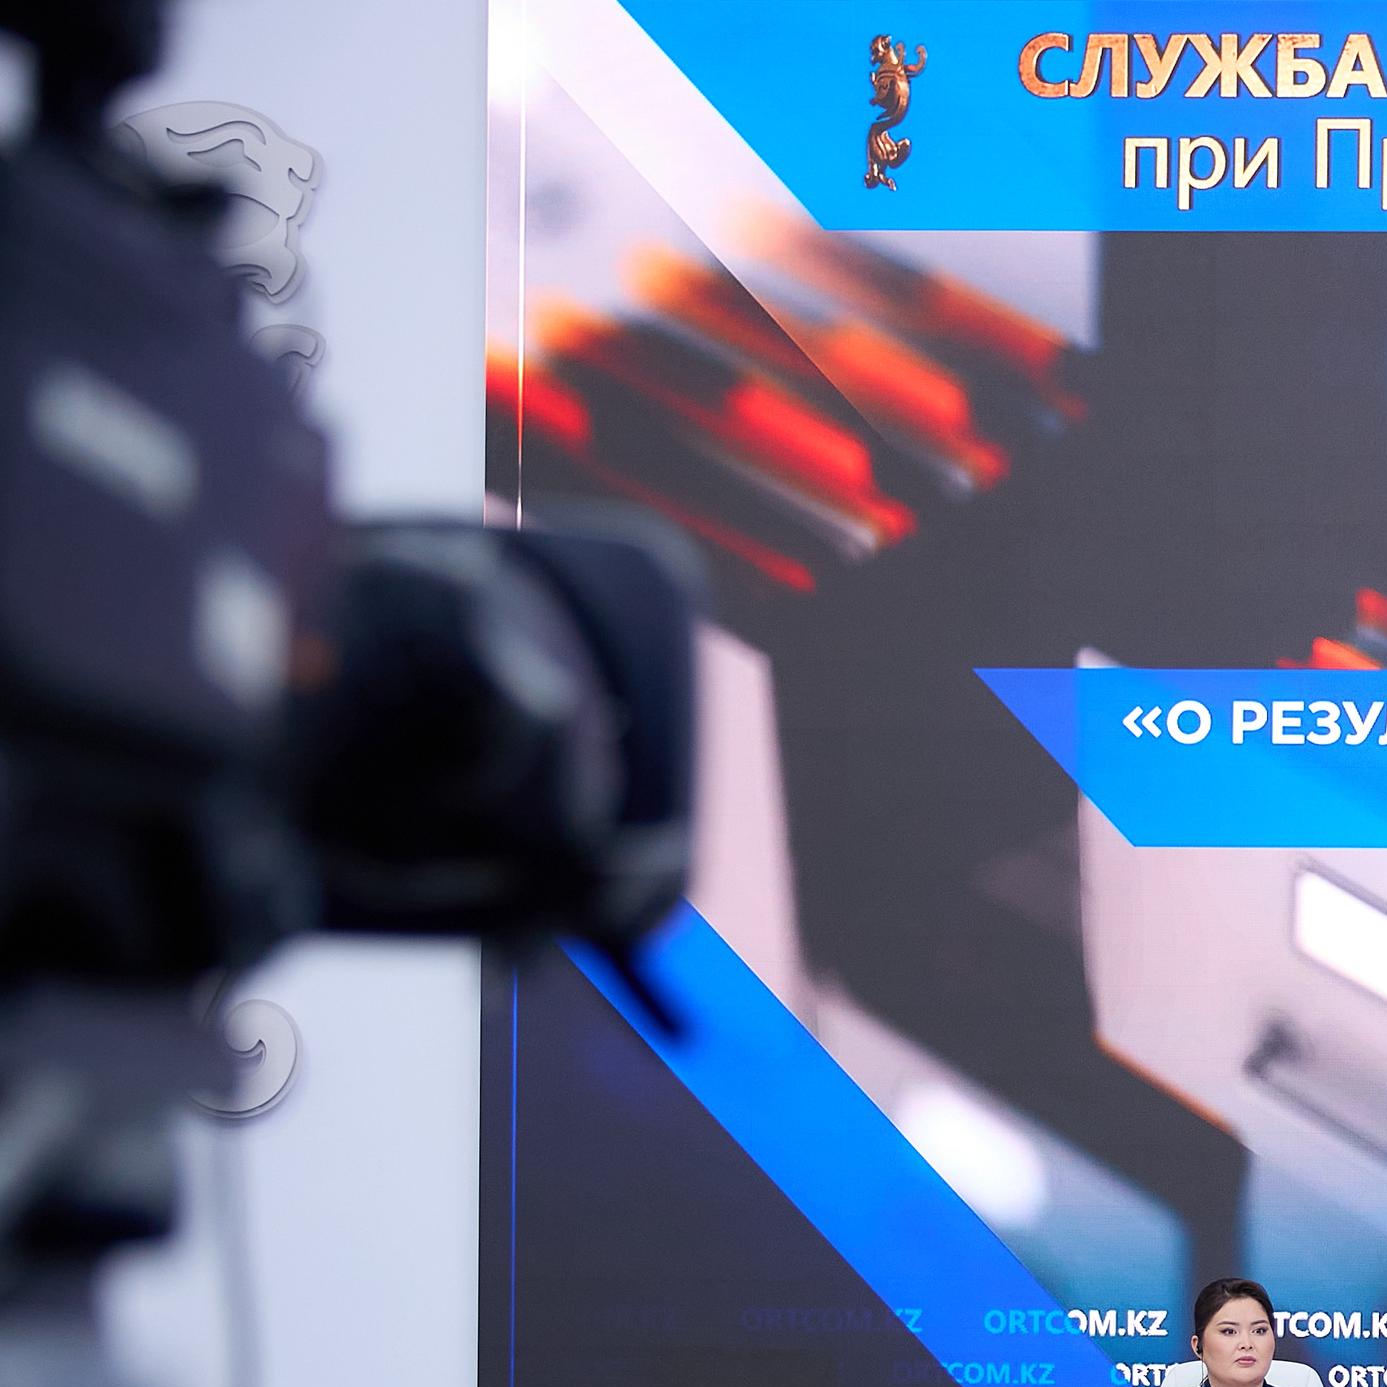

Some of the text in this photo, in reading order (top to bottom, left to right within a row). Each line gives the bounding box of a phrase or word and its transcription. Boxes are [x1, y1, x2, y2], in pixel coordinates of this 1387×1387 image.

[1123, 136, 1279, 210] при
[1122, 701, 1212, 745] «О
[984, 1310, 1168, 1337] ORTCOM.KZ
